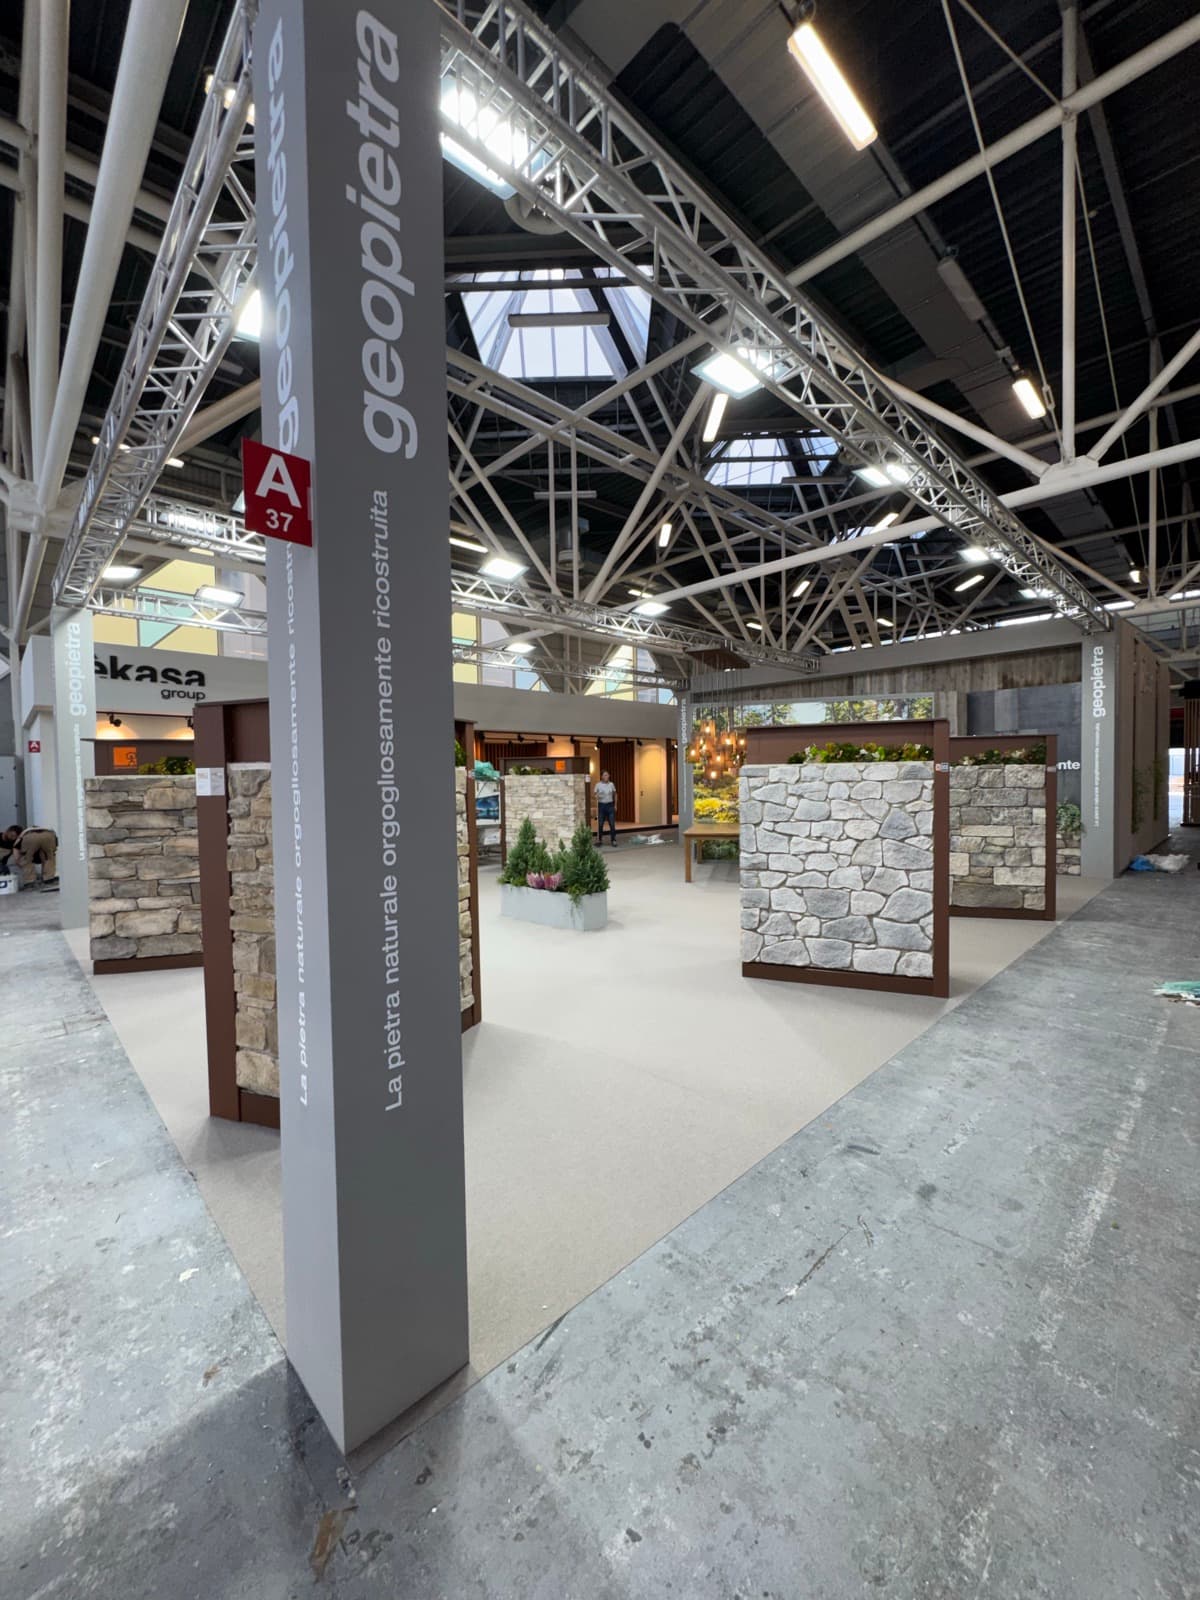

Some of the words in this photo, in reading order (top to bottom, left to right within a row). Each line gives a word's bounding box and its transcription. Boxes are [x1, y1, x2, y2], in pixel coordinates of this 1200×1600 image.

[267, 16, 299, 455] geopietra
[346, 11, 417, 460] geopietra
[255, 453, 302, 508] A
[265, 508, 293, 532] 37
[371, 490, 391, 629] ricostruita
[66, 622, 87, 717] geopietra
[160, 688, 206, 702] group
[1090, 645, 1106, 718] geopietra
[288, 643, 303, 868] orgogliosamente
[375, 636, 401, 867] orgogliosamente
[1056, 759, 1081, 770] nte
[294, 875, 305, 984] naturale
[380, 874, 400, 985] naturale
[297, 991, 309, 1069] pietra
[383, 990, 406, 1070] pietra
[299, 1073, 309, 1107] La
[384, 1074, 403, 1111] La
